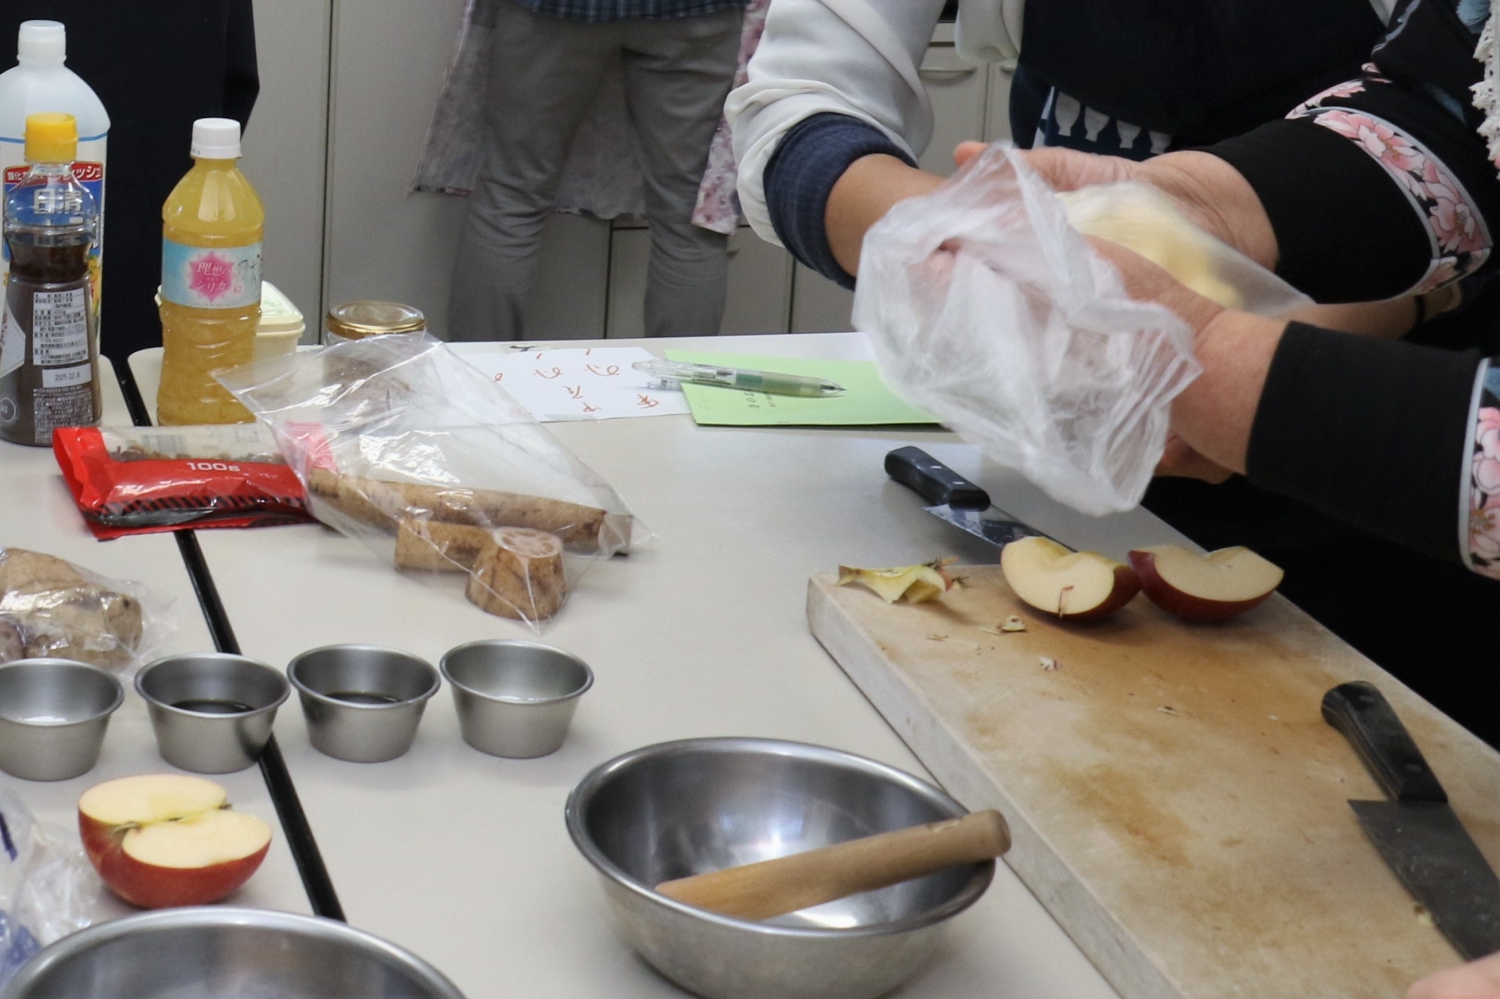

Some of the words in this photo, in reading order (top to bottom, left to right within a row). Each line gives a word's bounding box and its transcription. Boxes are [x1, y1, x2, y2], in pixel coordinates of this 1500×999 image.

[196, 280, 227, 293] シリカ
[186, 461, 241, 473] 100g
